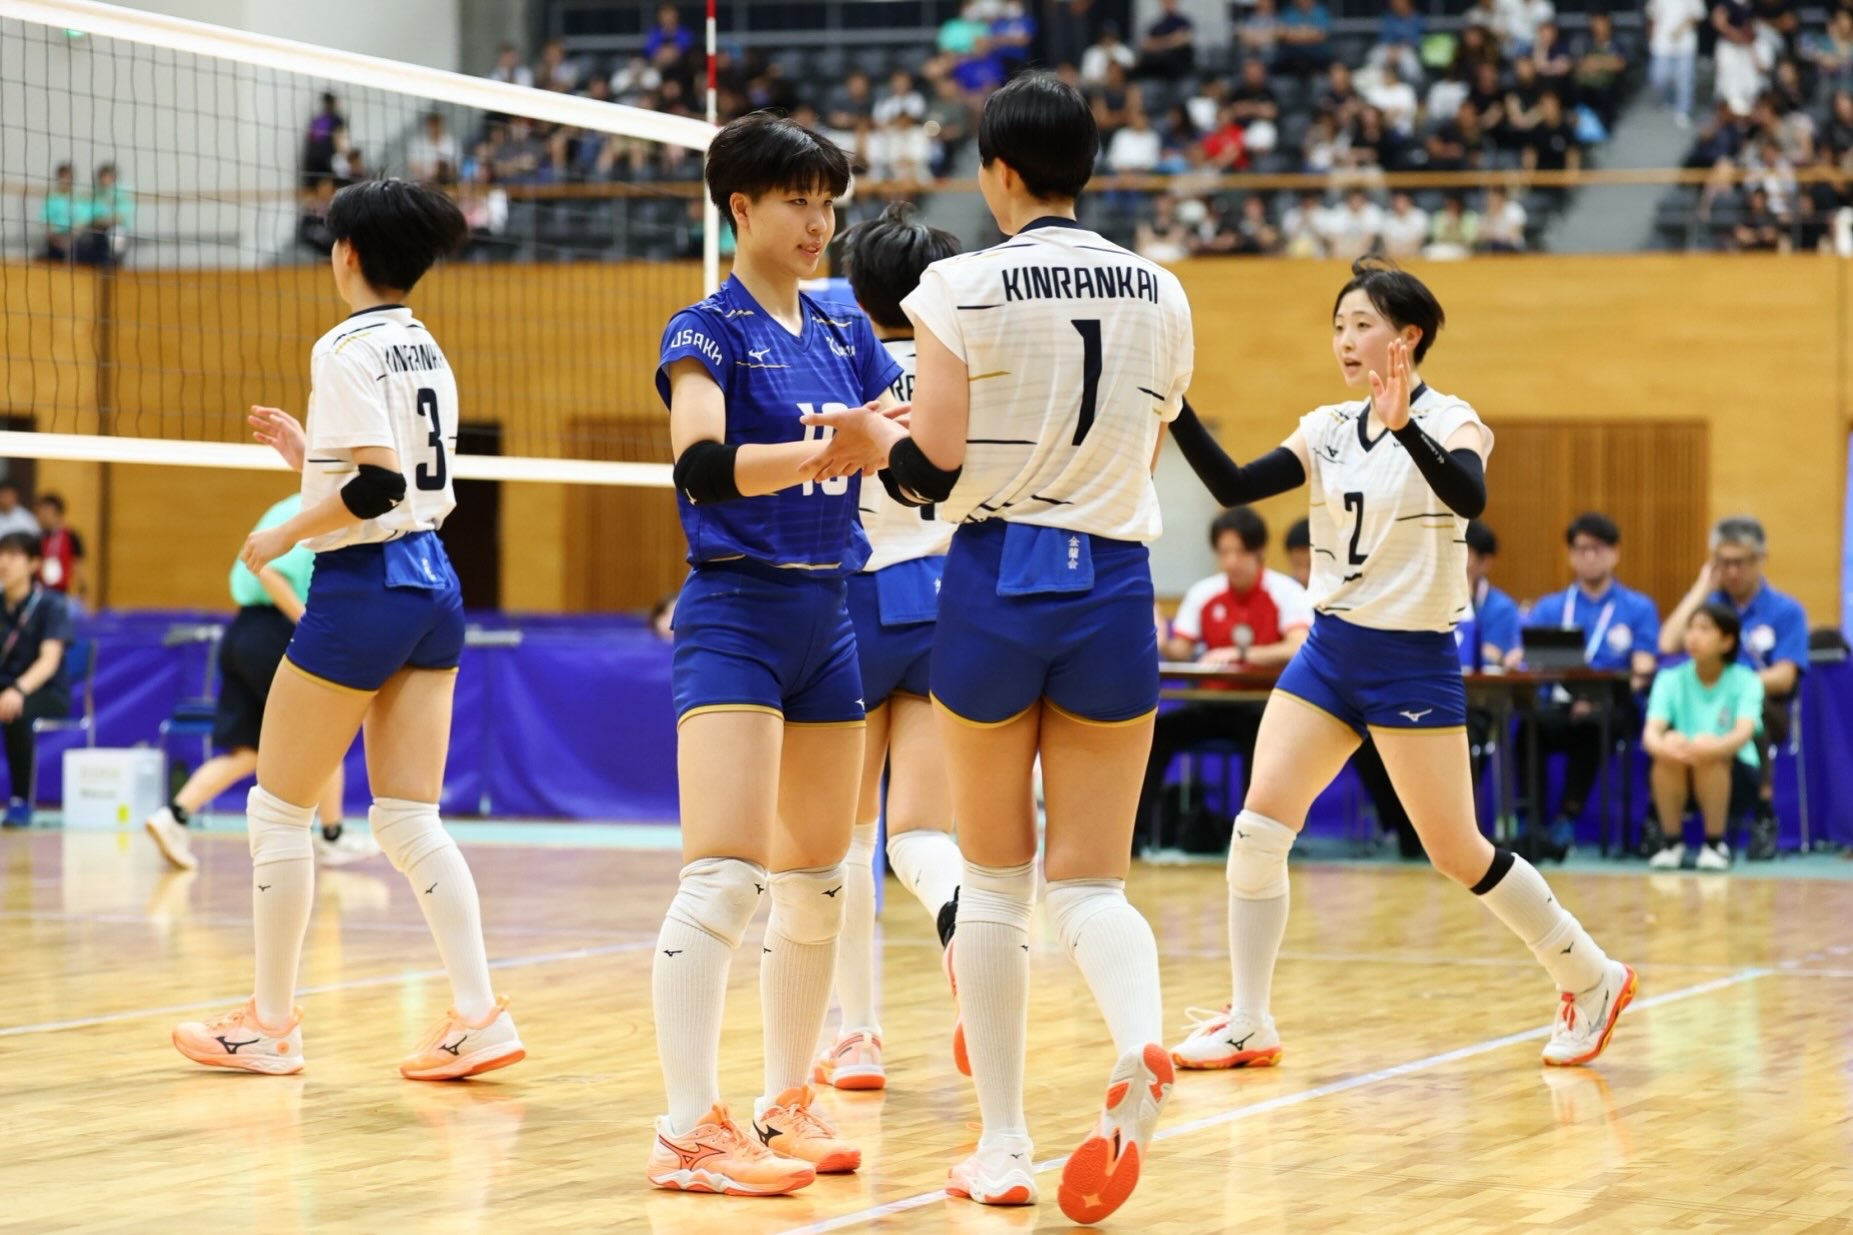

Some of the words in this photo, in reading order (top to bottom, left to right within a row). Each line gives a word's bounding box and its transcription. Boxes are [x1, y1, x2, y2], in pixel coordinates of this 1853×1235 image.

[1001, 266, 1158, 304] KINRANKAI
[1070, 319, 1103, 447] 1
[415, 387, 447, 491] 3
[1343, 491, 1369, 566] 2
